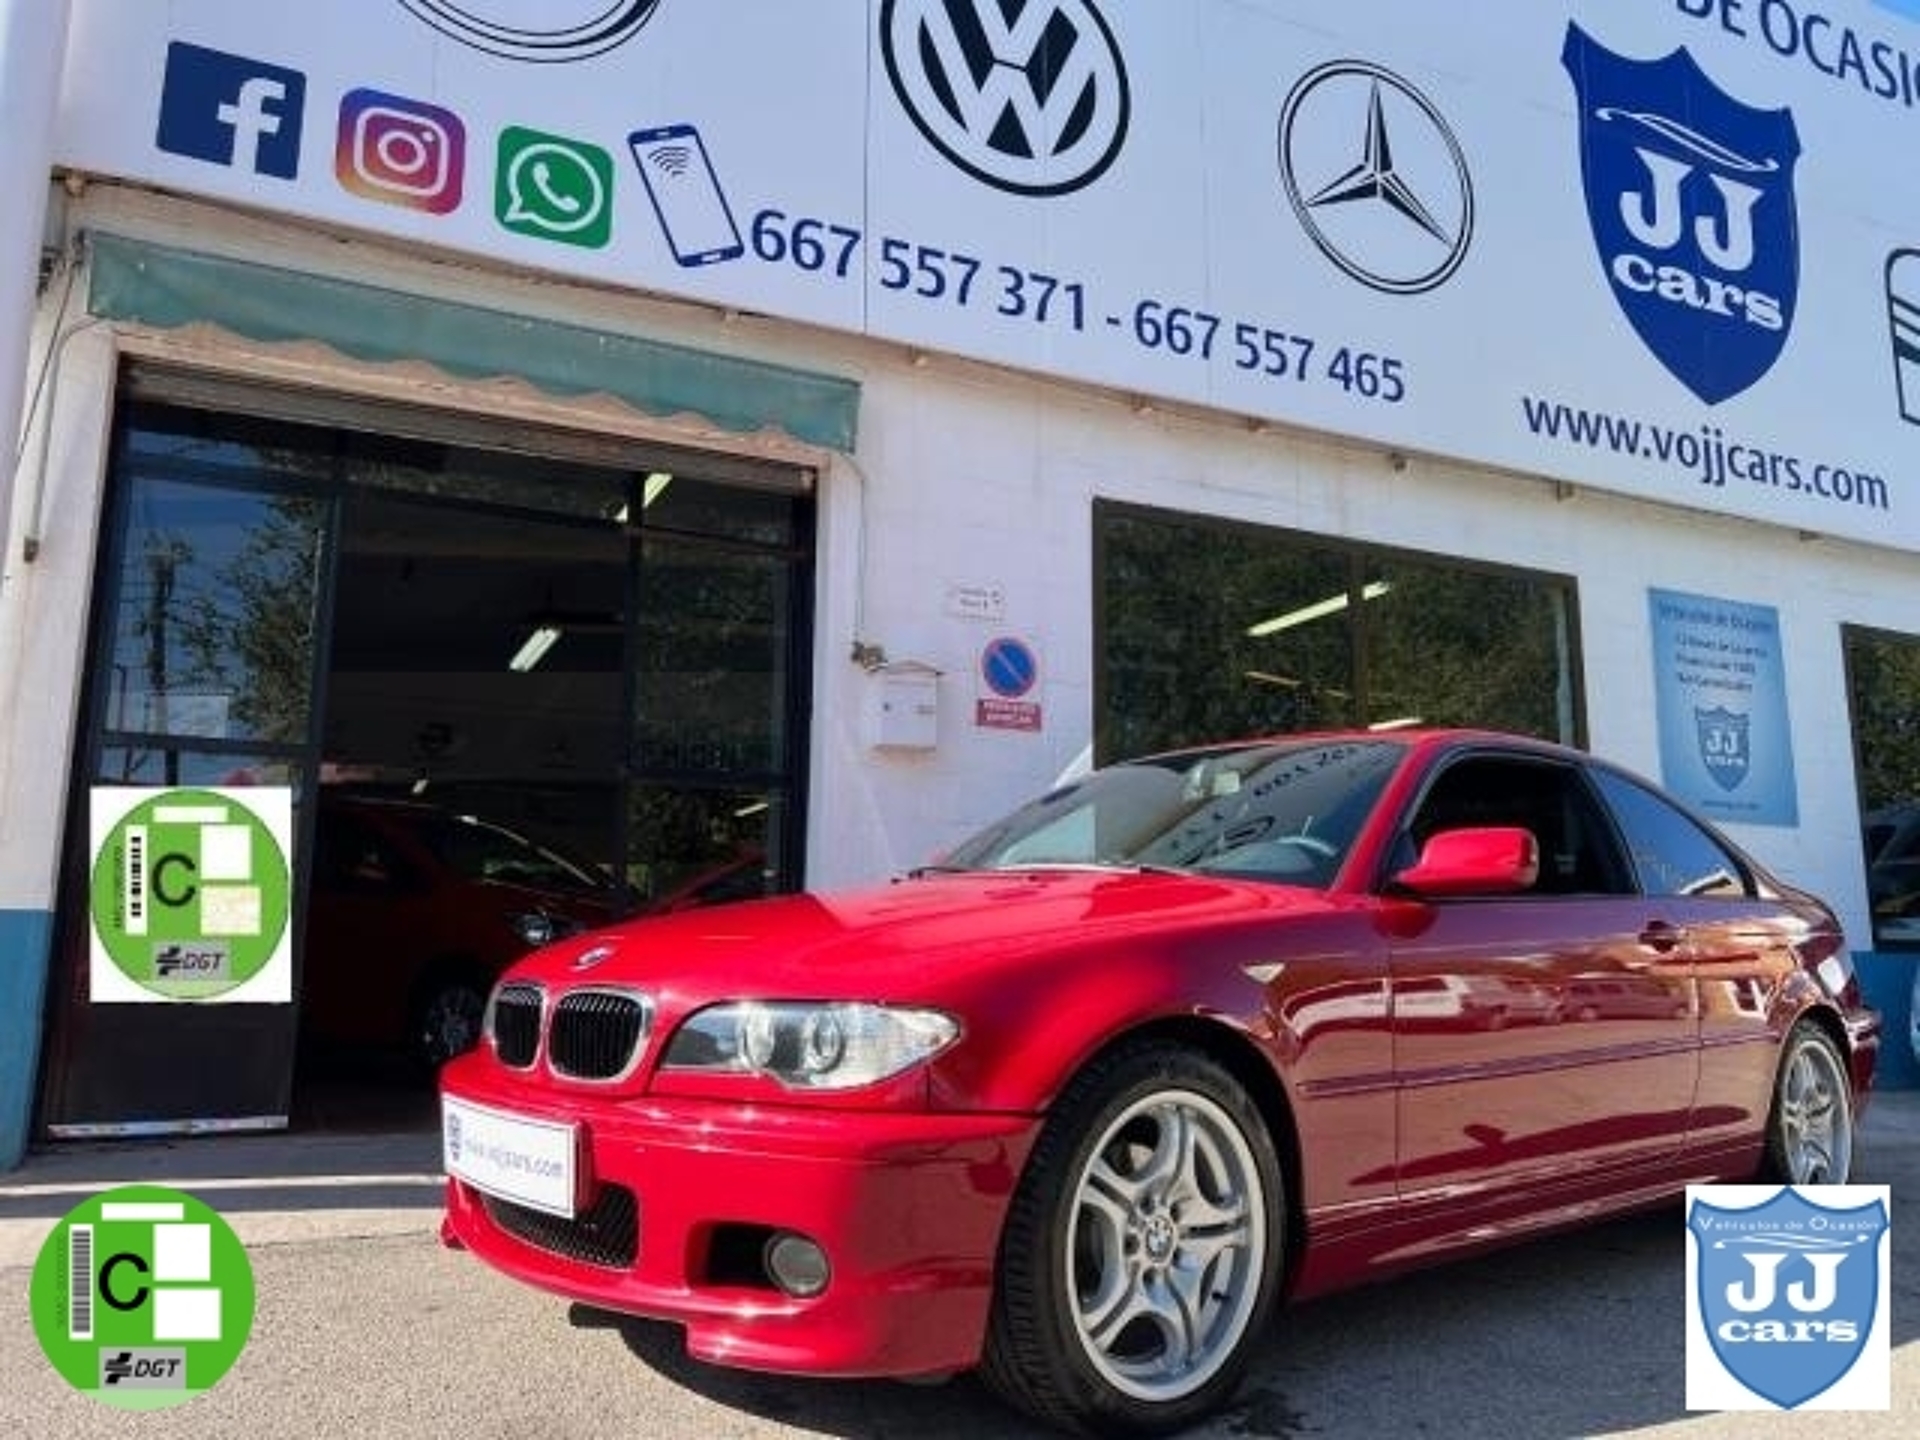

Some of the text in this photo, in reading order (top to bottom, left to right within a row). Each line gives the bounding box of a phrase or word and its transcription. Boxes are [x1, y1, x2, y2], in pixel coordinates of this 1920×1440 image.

[1760, 0, 1920, 107] OCASI
[1619, 146, 1765, 271] JJ
[750, 208, 862, 278] 667
[879, 236, 982, 306] 557
[996, 265, 1085, 331] 371
[1133, 299, 1221, 360] 667
[1234, 321, 1315, 382] 557
[1327, 347, 1406, 403] 465
[1612, 253, 1785, 331] cars
[1522, 396, 1889, 510] www.vojjcars.com
